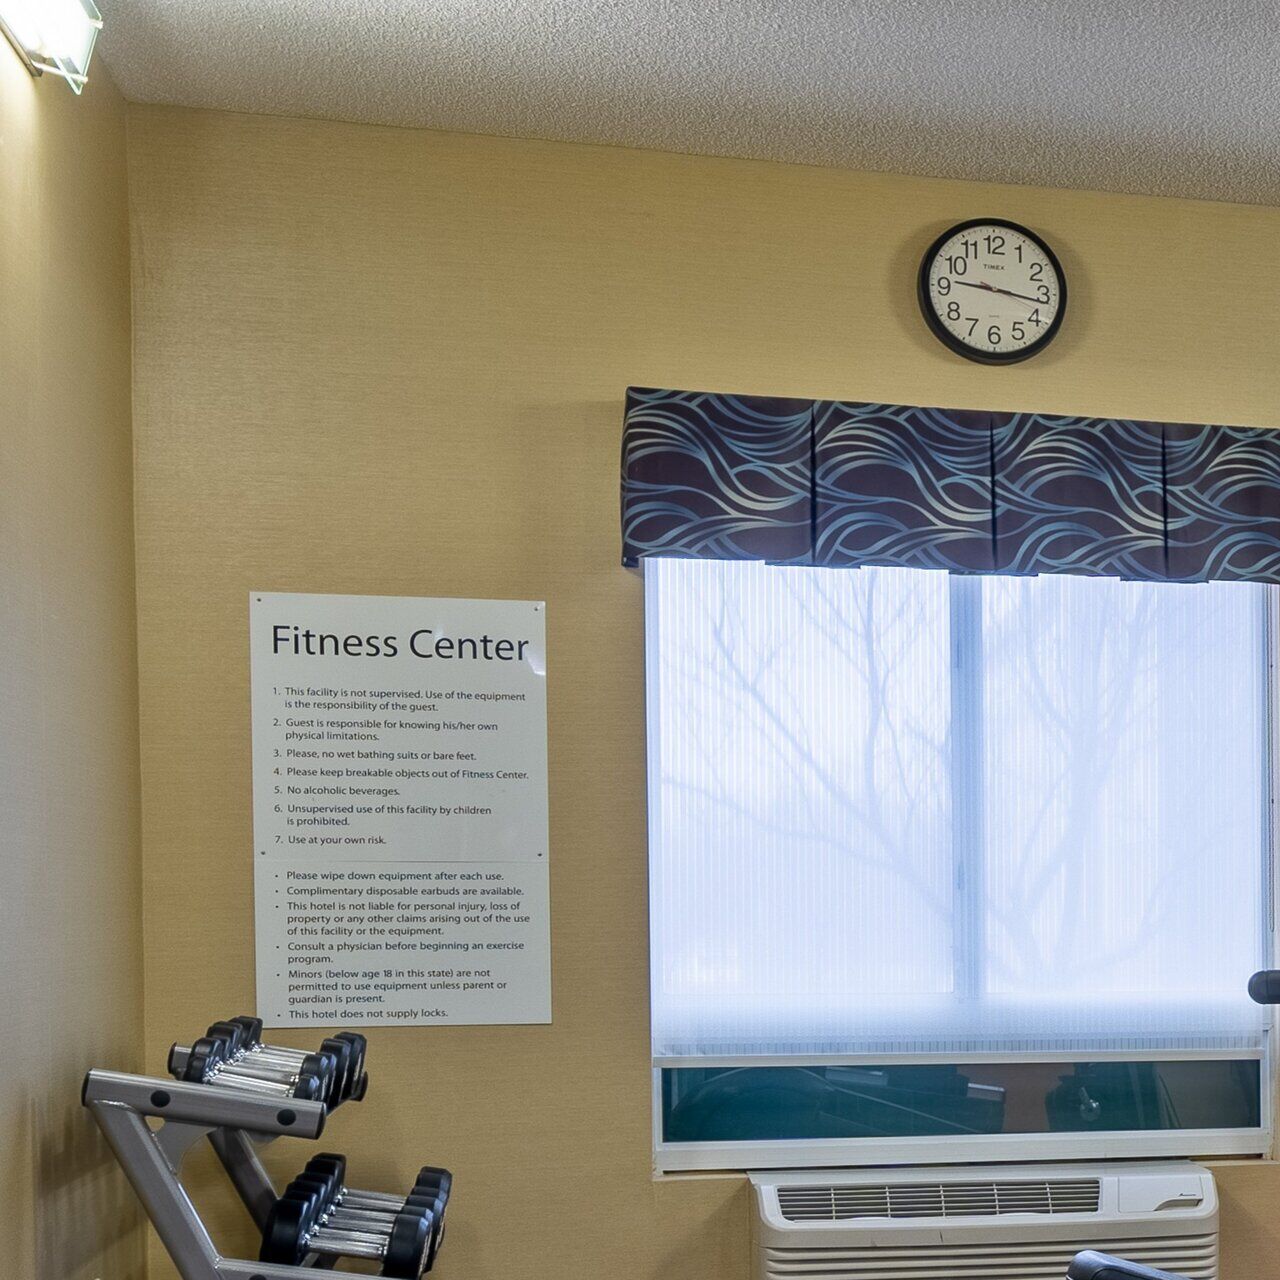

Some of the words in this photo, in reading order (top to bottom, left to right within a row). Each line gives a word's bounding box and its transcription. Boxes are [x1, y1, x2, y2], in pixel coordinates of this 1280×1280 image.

[961, 239, 978, 260] 11
[983, 235, 1005, 255] 12
[1014, 244, 1023, 264] 1
[945, 255, 967, 276] 10
[983, 263, 1005, 271] TIMEX
[1029, 262, 1043, 282] 2
[937, 276, 951, 296] 9
[1036, 285, 1050, 304] 3
[947, 301, 961, 321] 8
[1027, 308, 1042, 327] 4
[965, 317, 979, 337] 7
[1011, 321, 1025, 341] 5
[987, 325, 1001, 345] 6
[272, 624, 398, 658] Fitness
[409, 628, 529, 661] Center
[273, 687, 280, 695] 1.
[284, 686, 304, 696] This
[306, 686, 339, 698] facility
[340, 688, 348, 697] is
[350, 689, 366, 697] not
[368, 688, 423, 700] supervised.
[425, 690, 443, 699] Use
[444, 690, 455, 699] of
[456, 691, 472, 699] the
[474, 691, 525, 702] equipment
[284, 699, 292, 708] is
[293, 698, 311, 709] the
[310, 698, 378, 712] responsibility
[378, 699, 391, 710] of
[390, 700, 408, 711] the
[408, 700, 439, 713] guest.
[272, 717, 282, 727] 2.
[285, 717, 314, 728] Guest
[315, 718, 324, 728] is
[325, 718, 382, 730] responsible
[382, 718, 397, 729] for
[398, 719, 441, 731] knowing
[442, 720, 476, 731] his/her
[476, 722, 498, 731] own
[284, 729, 325, 742] physical
[326, 729, 380, 742] limitations.
[272, 748, 282, 758] 3.
[286, 748, 320, 759] Please,
[336, 750, 355, 759] wet
[356, 749, 395, 761] bathing
[395, 750, 419, 760] suits
[420, 752, 432, 760] or
[432, 750, 455, 761] bare
[455, 750, 477, 760] feet.
[272, 766, 282, 776] 4.
[286, 766, 319, 777] Please
[319, 766, 344, 778] keep
[344, 767, 393, 778] breakable
[394, 767, 430, 779] objects
[430, 770, 448, 778] out
[449, 768, 461, 778] of
[461, 769, 495, 779] Fitness
[495, 769, 529, 779] Center.
[273, 785, 283, 794] 5.
[286, 784, 302, 795] No
[302, 784, 348, 796] alcoholic
[348, 785, 400, 797] beverages.
[273, 803, 283, 813] 6.
[287, 803, 354, 815] Unsupervised
[355, 805, 373, 814] use
[374, 803, 387, 814] of
[386, 804, 405, 814] this
[405, 804, 438, 816] facility
[438, 805, 452, 816] by
[452, 805, 491, 815] children
[286, 816, 295, 825] is
[294, 815, 350, 827] prohibited.
[274, 834, 284, 844] 7.
[287, 834, 307, 844] Use
[307, 836, 318, 844] at
[319, 836, 343, 846] your
[343, 836, 366, 844] own
[367, 835, 387, 844] risk.
[286, 870, 319, 880] Please
[319, 870, 345, 882] wipe
[346, 870, 376, 881] down
[377, 871, 433, 882] equipment
[433, 870, 458, 880] after
[459, 871, 483, 880] each
[484, 873, 504, 881] use.
[286, 885, 364, 897] Complimentary
[365, 885, 419, 897] disposable
[420, 886, 460, 896] earbuds
[461, 888, 478, 896] are
[479, 885, 524, 896] available.
[286, 901, 309, 911] This
[309, 901, 336, 911] hotel
[337, 901, 348, 911] is
[348, 902, 367, 911] not
[367, 900, 395, 911] liable
[396, 900, 412, 911] for
[413, 901, 456, 912] personal
[457, 901, 488, 912] injury,
[489, 900, 508, 911] loss
[509, 901, 520, 911] of
[286, 914, 331, 925] property
[333, 915, 345, 923] or
[346, 913, 365, 925] any
[366, 913, 394, 924] other
[395, 913, 427, 924] claims
[428, 913, 461, 925] arising
[462, 914, 480, 923] out
[481, 913, 494, 923] of
[494, 913, 511, 923] the
[513, 915, 530, 923] use
[287, 926, 297, 935] of
[300, 926, 317, 935] this
[320, 926, 353, 937] facility
[369, 926, 385, 935] the
[388, 927, 444, 936] equipment.
[287, 941, 325, 951] Consult
[327, 943, 334, 951] a
[336, 940, 384, 952] physician
[384, 940, 418, 951] before
[418, 940, 469, 952] beginning
[470, 942, 484, 950] an
[485, 940, 524, 950] exercise
[287, 955, 334, 965] program.
[287, 968, 323, 979] Minors
[324, 968, 359, 979] (below
[360, 970, 380, 980] age
[382, 969, 393, 978] 18
[394, 968, 405, 978] in
[406, 968, 425, 978] this
[426, 968, 454, 979] state)
[454, 969, 471, 977] are
[472, 969, 491, 977] not
[287, 1008, 309, 1020] This
[311, 1008, 338, 1020] hotel
[339, 1008, 364, 1019] does
[365, 1009, 384, 1019] not
[385, 1008, 419, 1019] supply
[420, 1007, 448, 1018] locks.
